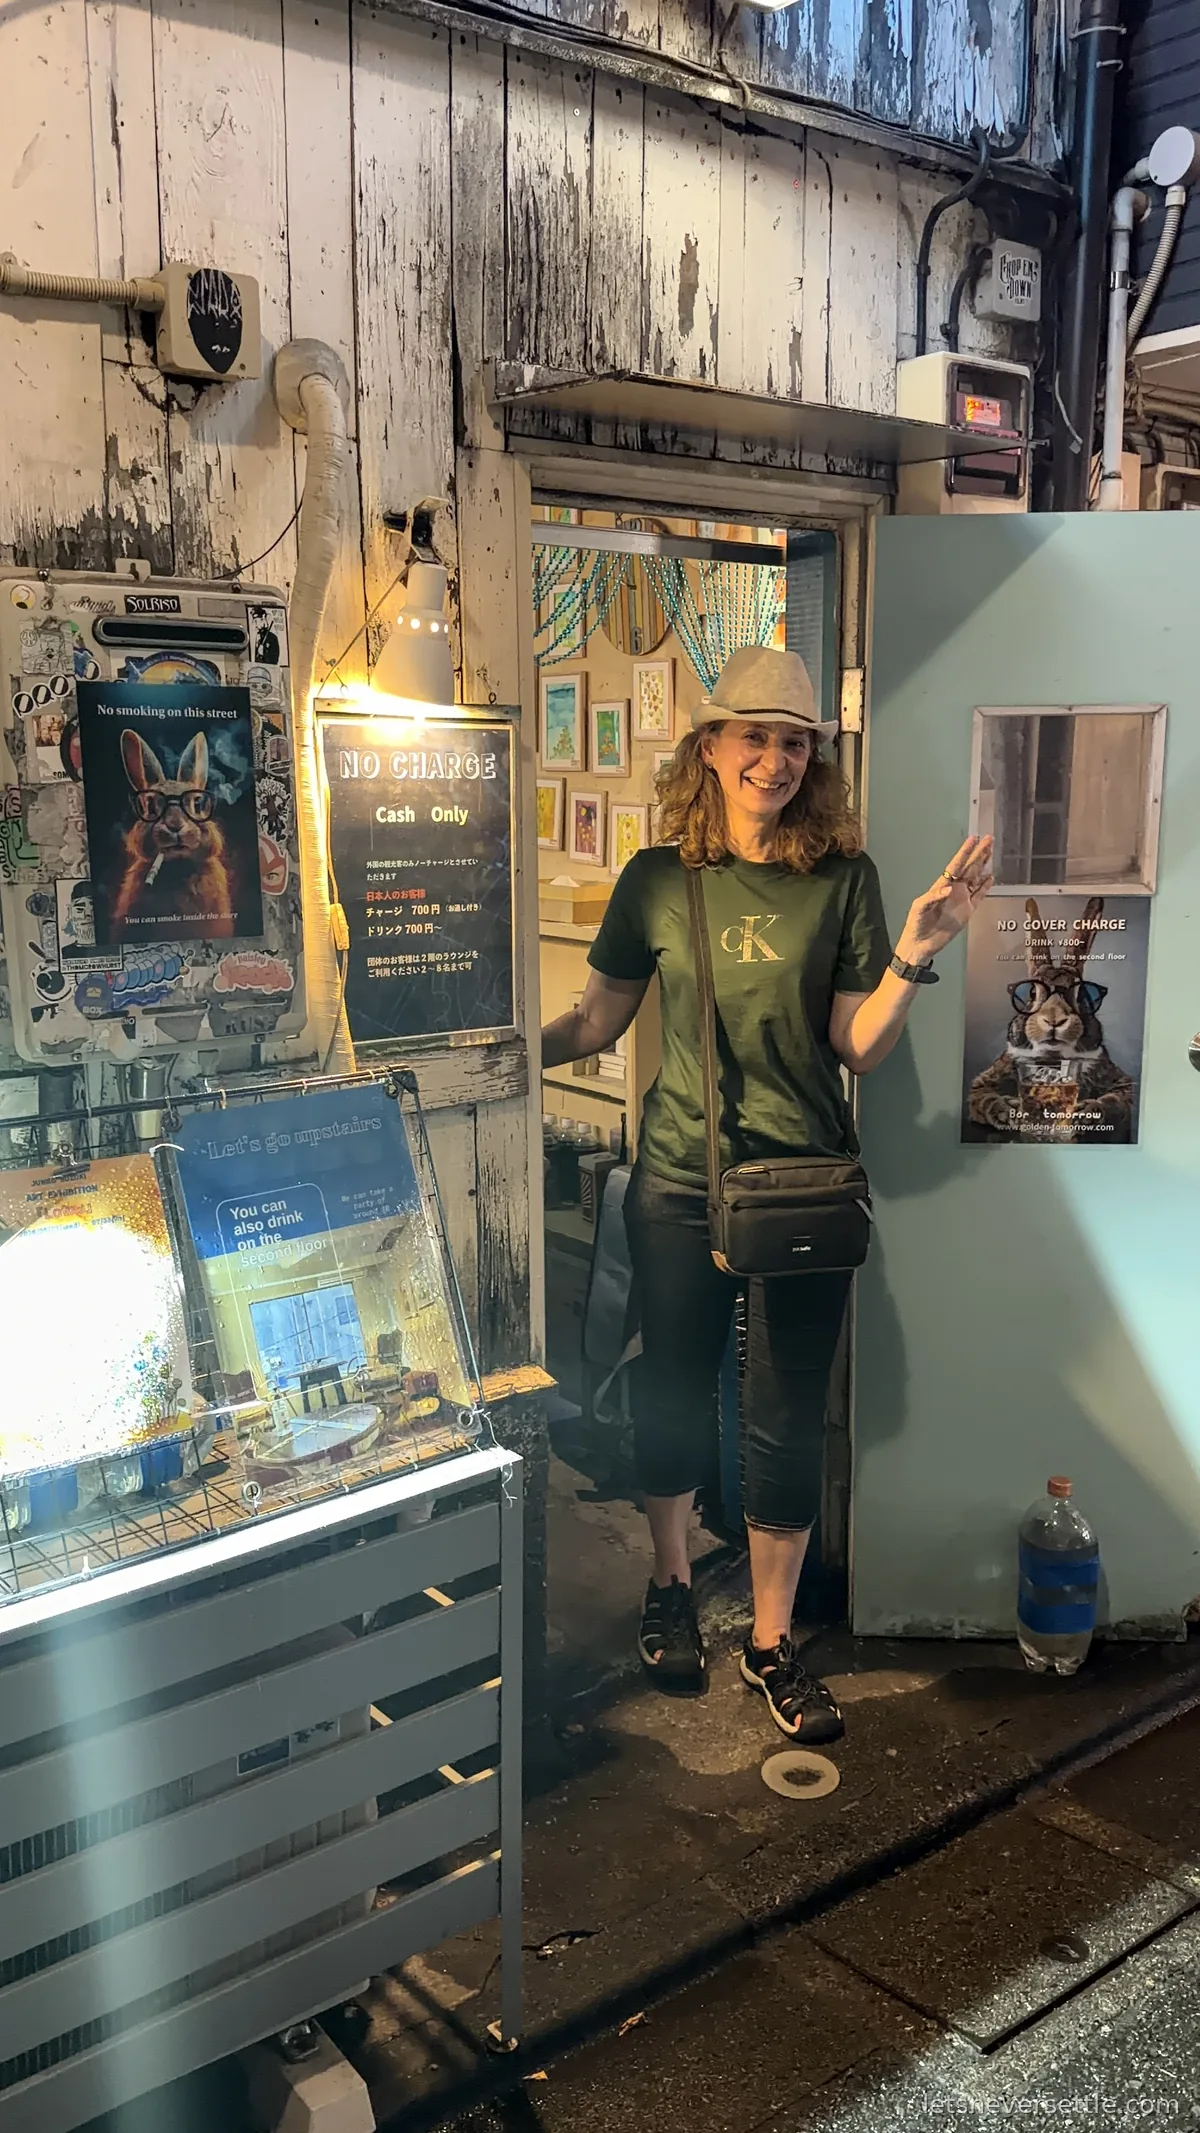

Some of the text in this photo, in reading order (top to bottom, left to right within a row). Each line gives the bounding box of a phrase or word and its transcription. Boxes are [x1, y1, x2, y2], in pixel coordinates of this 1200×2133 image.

[97, 704, 237, 719] No smoking on this street
[340, 750, 497, 779] NO CHARGE
[376, 805, 469, 825] Cash Only
[366, 889, 426, 902] 日本人のお客様
[125, 916, 140, 924] You
[157, 914, 181, 922] smoke
[182, 913, 205, 921] inside
[207, 912, 219, 920] the
[366, 905, 403, 918] チャージ
[411, 904, 440, 915] 700円
[997, 919, 1127, 931] NO COVER CHARGE
[1025, 938, 1054, 946] DRINK
[1009, 1108, 1101, 1119] Bar tomorrow
[997, 1122, 1115, 1133] www.golden-tomorrow.com
[208, 1116, 381, 1160] Let's go upstairs
[229, 1200, 287, 1220] You can
[234, 1210, 304, 1236] also drink
[237, 1232, 282, 1251] on the
[240, 1238, 328, 1267] second floor
